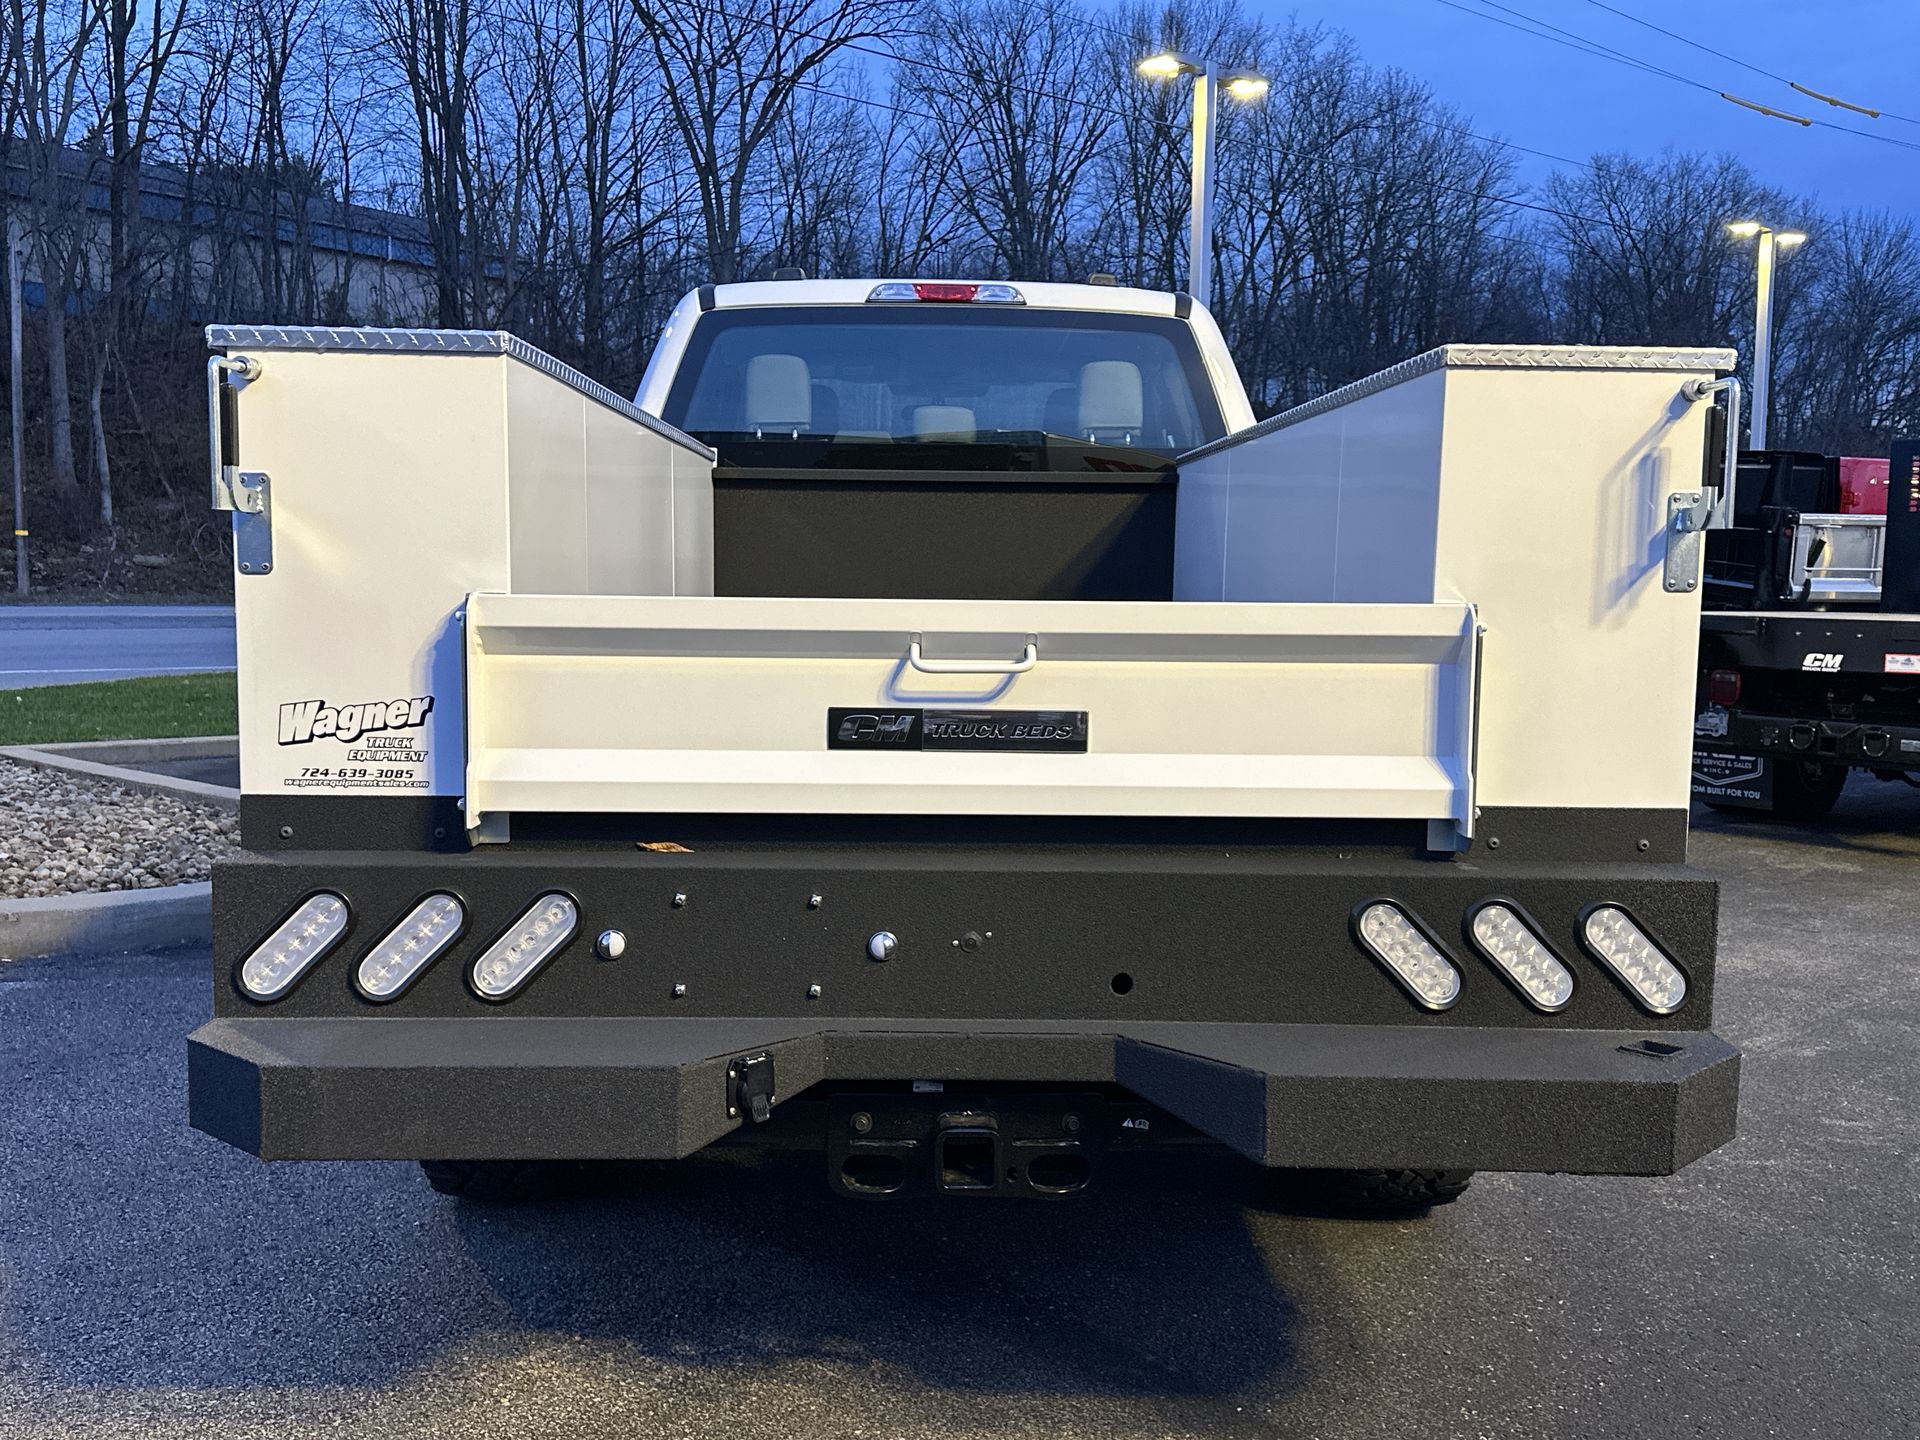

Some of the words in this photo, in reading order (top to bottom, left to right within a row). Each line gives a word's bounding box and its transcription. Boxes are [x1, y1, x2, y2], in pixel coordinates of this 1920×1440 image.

[1803, 653, 1844, 668] CM
[278, 695, 435, 746] Wagner
[837, 714, 915, 743] CM
[932, 722, 1006, 739] TRUCK
[1009, 724, 1073, 739] BEDS
[366, 737, 415, 749] TRUCK
[347, 750, 428, 762] EQUIPMENT
[1702, 758, 1726, 767] SERVICE
[1734, 761, 1753, 769] SALES
[301, 768, 414, 779] 724-639-3085
[284, 778, 430, 788] wagnerequipmentsales.com
[1706, 786, 1726, 796] BUILT
[1727, 788, 1742, 797] FOR
[1743, 790, 1761, 800] YOU
